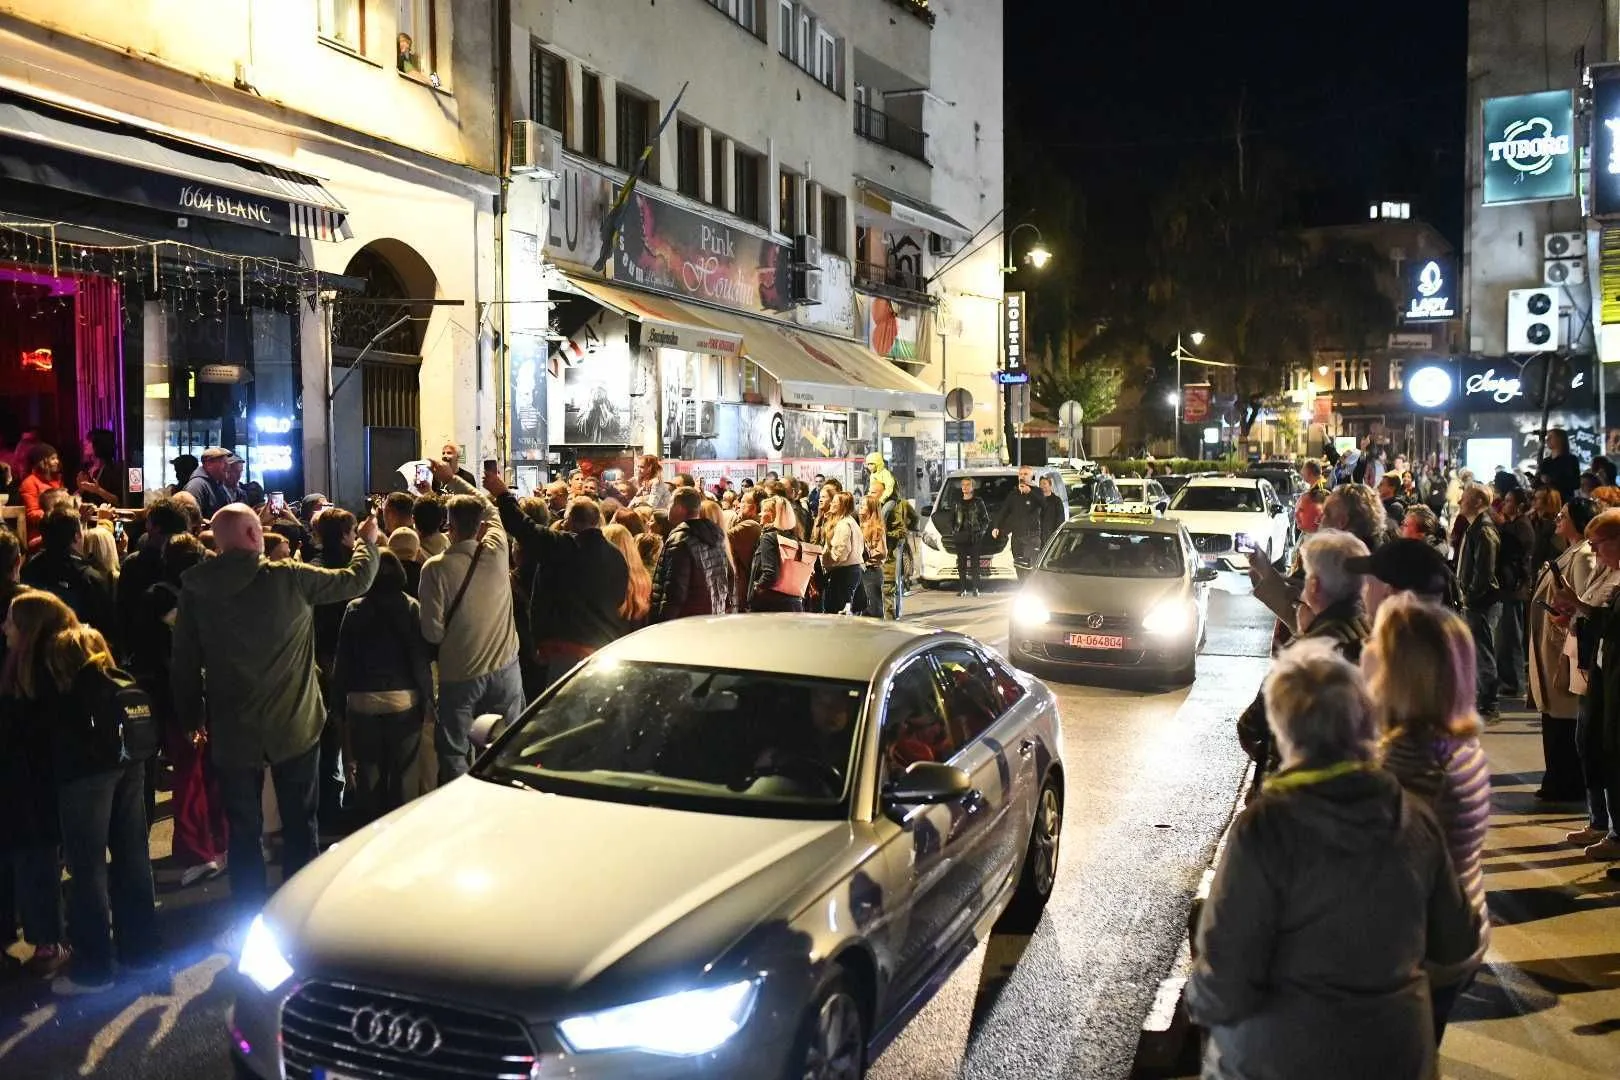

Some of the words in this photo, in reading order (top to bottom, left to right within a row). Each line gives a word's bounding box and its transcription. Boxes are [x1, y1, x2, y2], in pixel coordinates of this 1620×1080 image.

[1489, 135, 1569, 162] TUBORG
[179, 185, 215, 212] 1664
[215, 195, 271, 224] BLANC
[701, 224, 735, 258] Pink
[683, 256, 755, 305] Houdini
[1008, 296, 1019, 369] HOSTEL
[1072, 634, 1121, 647] TA-064804
